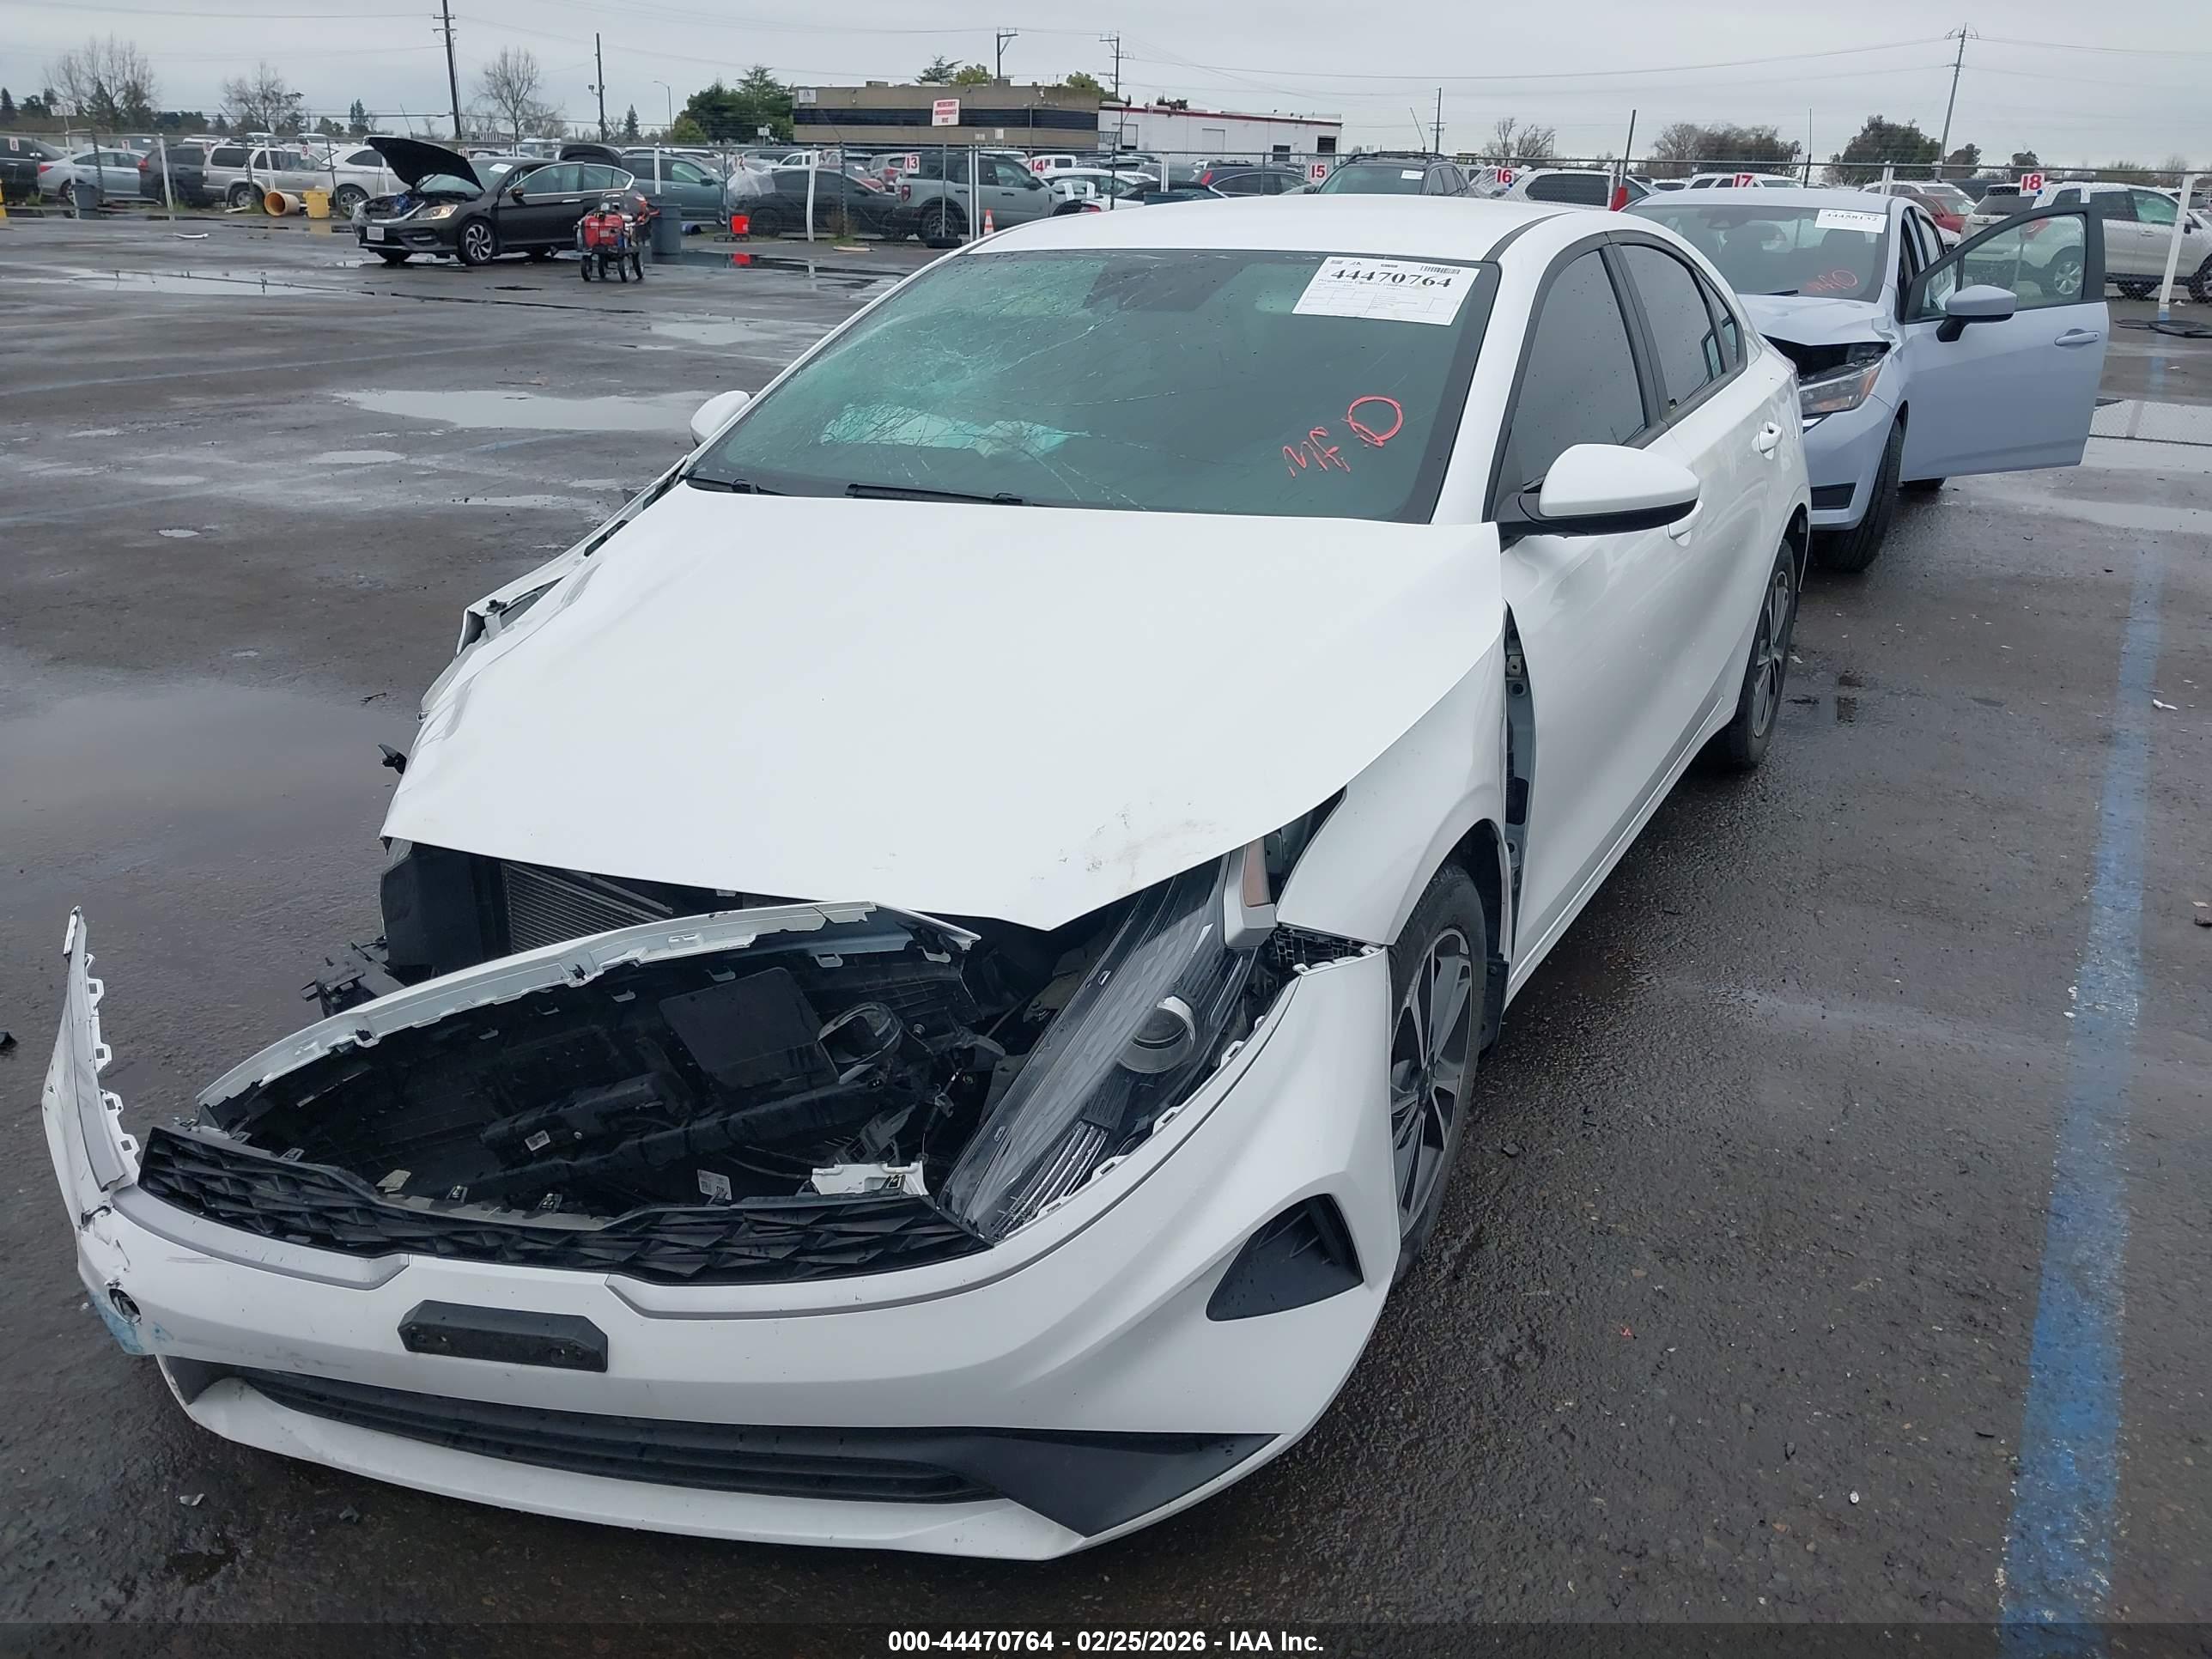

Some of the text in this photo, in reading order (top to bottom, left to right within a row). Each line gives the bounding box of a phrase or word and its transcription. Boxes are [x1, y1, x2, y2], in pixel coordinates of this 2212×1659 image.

[302, 146, 309, 156] 9
[734, 155, 744, 167] 12
[907, 157, 918, 169] 13
[1031, 159, 1044, 172] 14
[1310, 164, 1326, 179] 15
[1497, 169, 1512, 183] 16
[1734, 174, 1753, 188] 17
[2022, 174, 2042, 191] 18
[1331, 269, 1452, 288] 44470764
